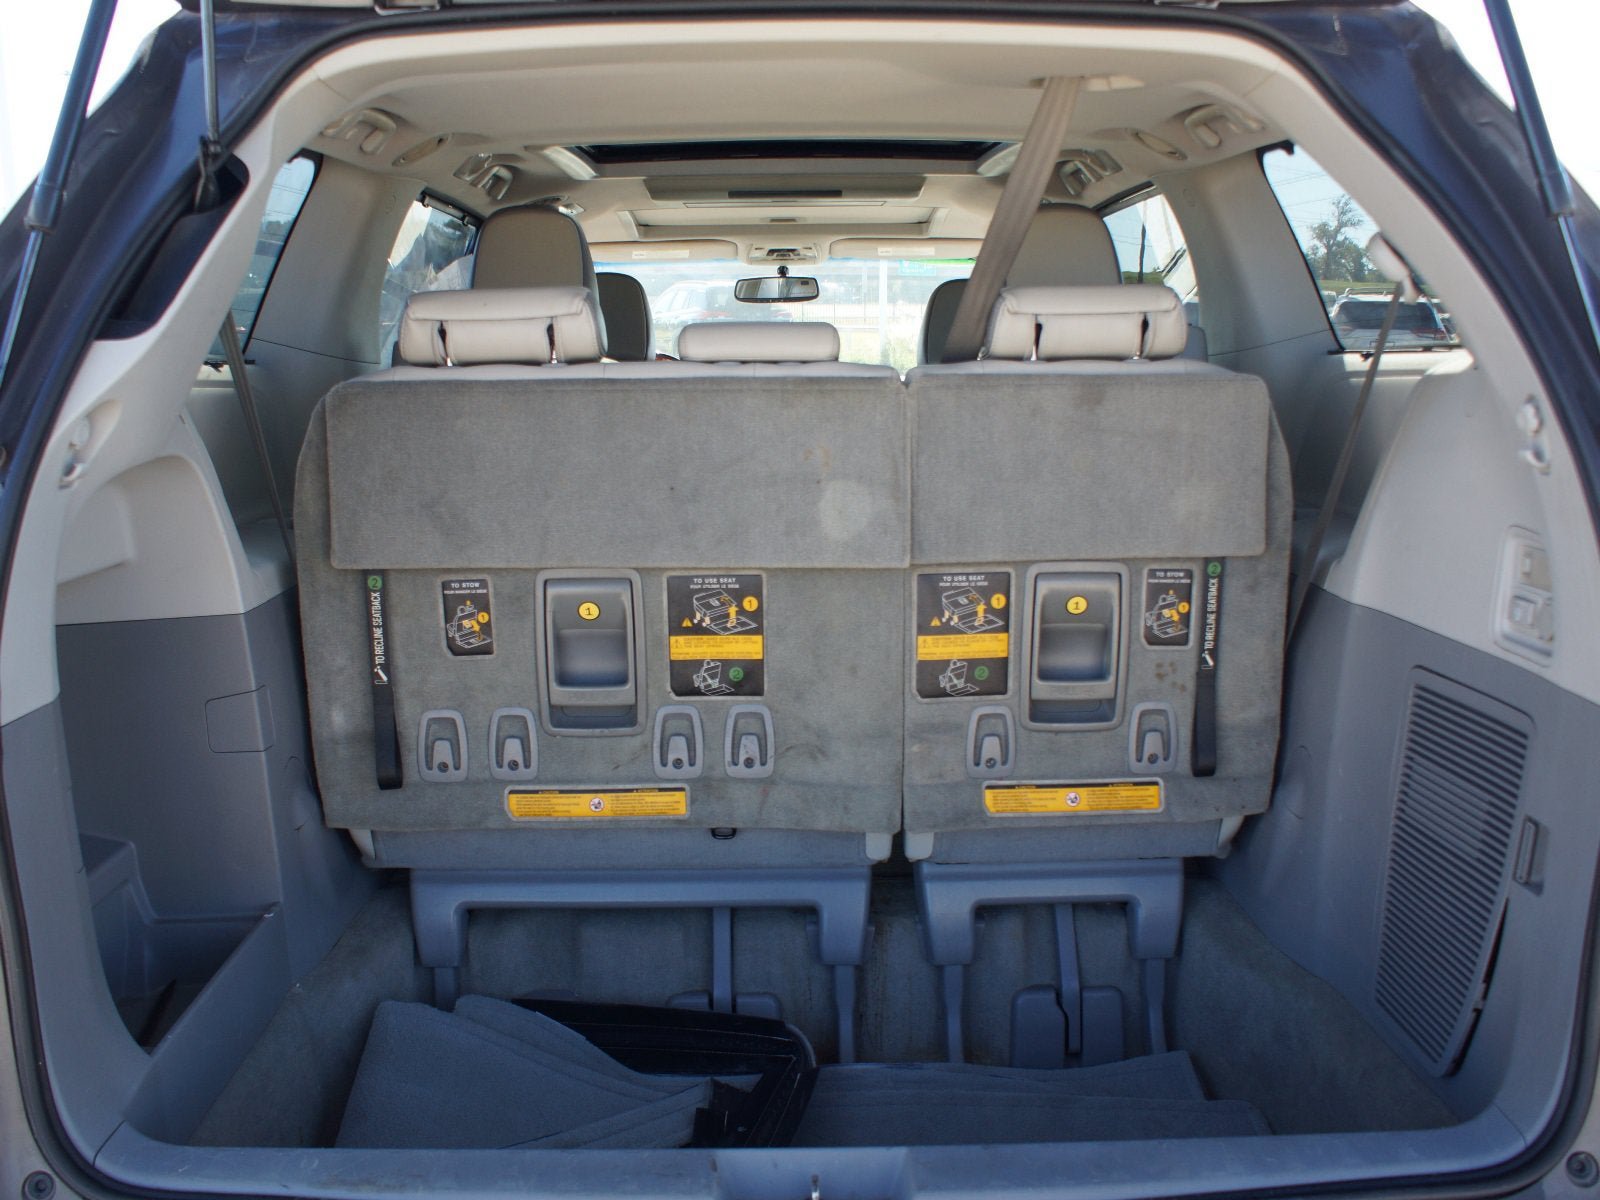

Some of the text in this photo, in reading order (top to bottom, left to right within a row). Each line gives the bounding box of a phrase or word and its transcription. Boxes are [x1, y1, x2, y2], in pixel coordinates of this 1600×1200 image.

[371, 592, 386, 664] TO RECLINE SEATBACK
[1204, 578, 1219, 649] TO RECLINE SEATBACK
